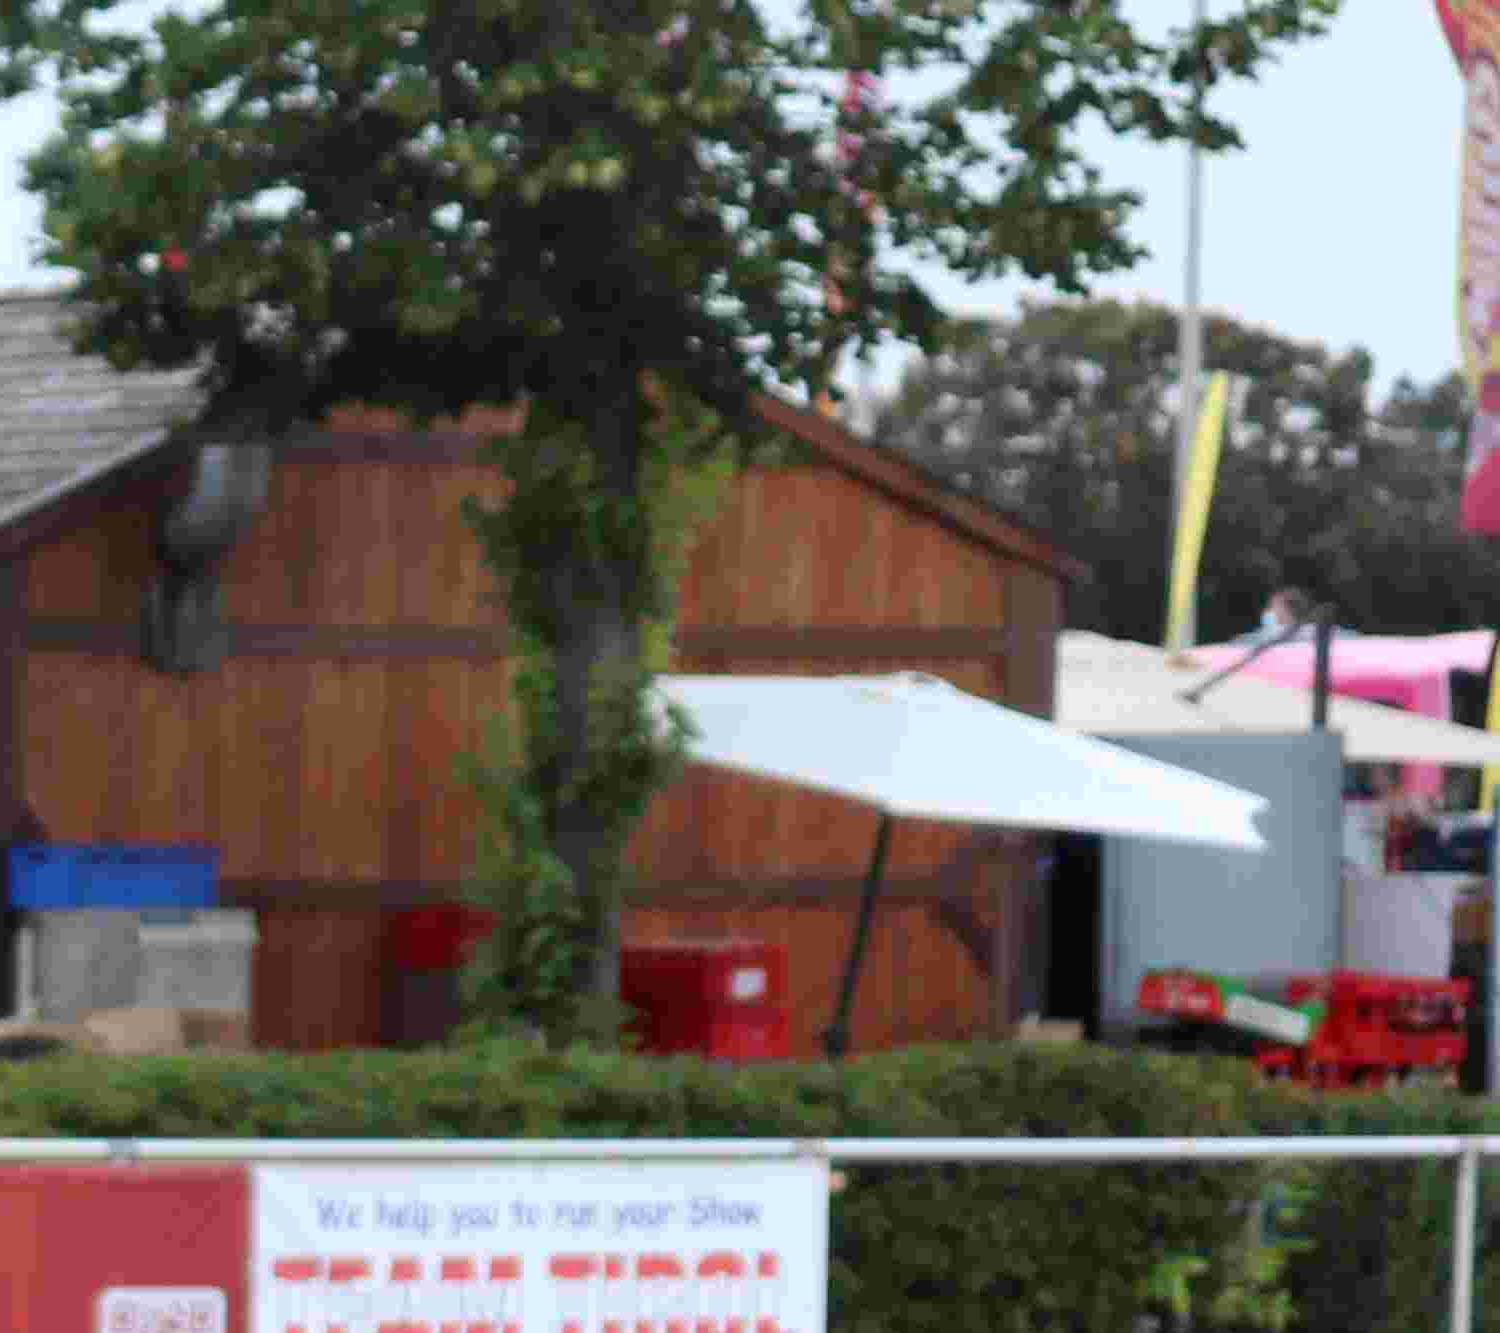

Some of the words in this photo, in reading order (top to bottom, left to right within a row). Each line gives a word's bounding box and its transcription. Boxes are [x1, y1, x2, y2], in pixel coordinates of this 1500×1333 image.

[377, 1197, 434, 1237] help
[450, 1203, 498, 1236] you
[510, 1198, 540, 1228] to
[555, 1202, 597, 1227] run
[615, 1202, 672, 1232] your
[687, 1195, 763, 1226] Show
